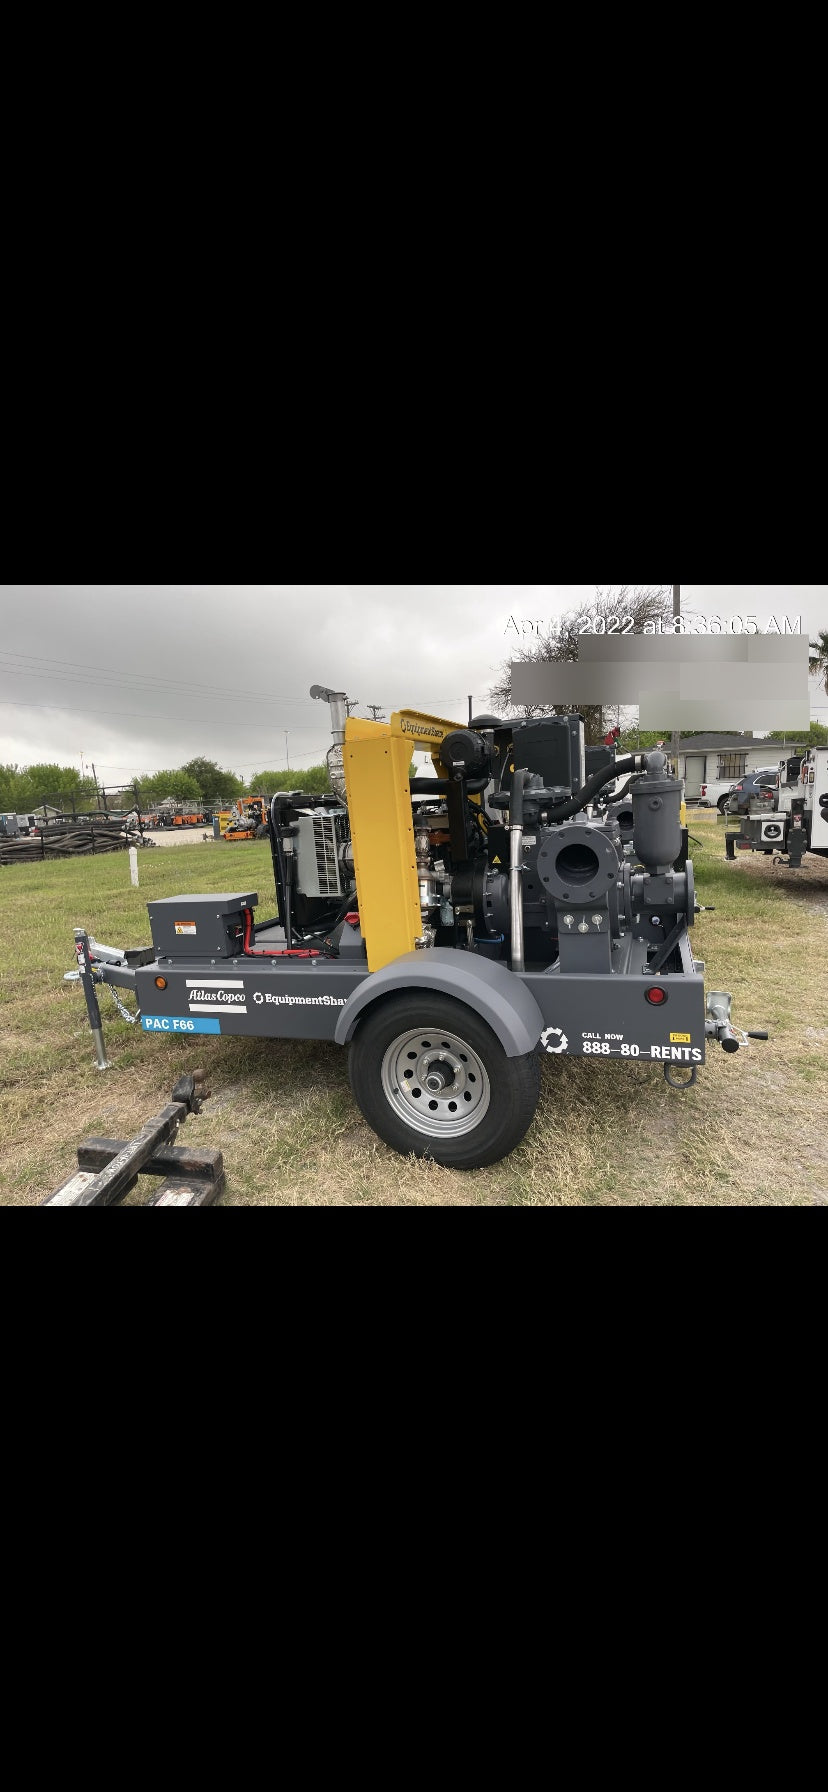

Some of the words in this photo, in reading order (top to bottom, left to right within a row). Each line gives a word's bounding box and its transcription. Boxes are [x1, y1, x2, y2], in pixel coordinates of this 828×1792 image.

[145, 1017, 170, 1030] PAC
[173, 1019, 195, 1031] F66
[582, 1032, 601, 1040] CALL
[604, 1033, 624, 1041] NOW
